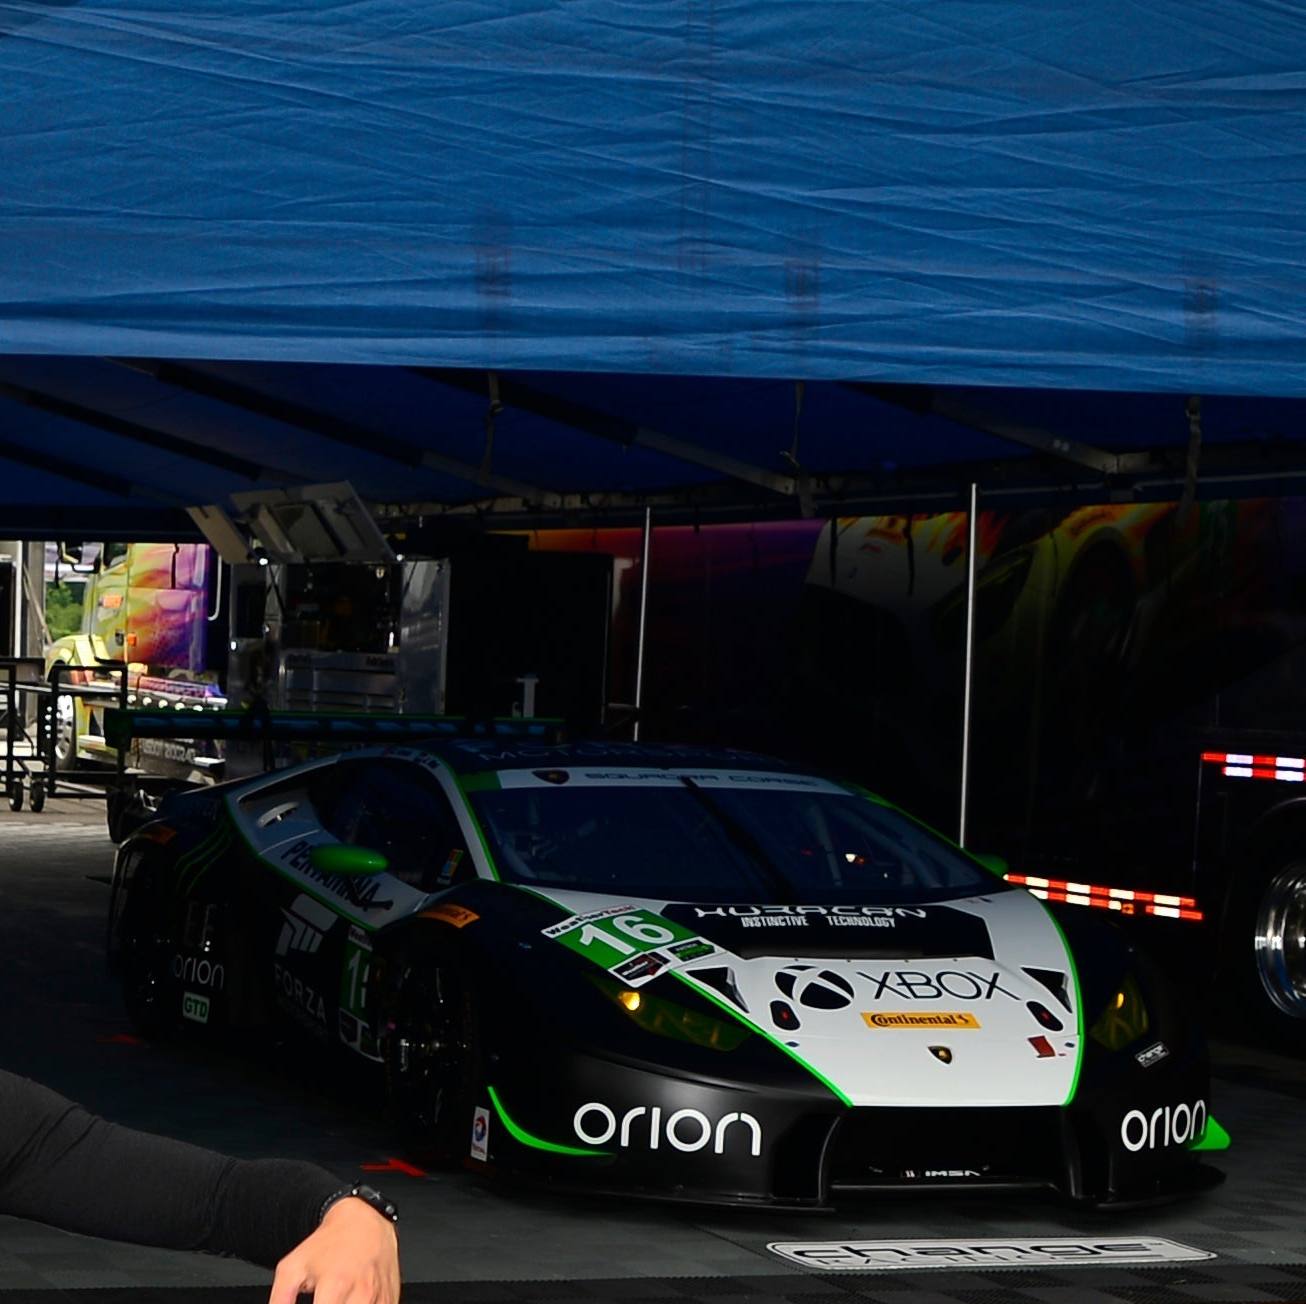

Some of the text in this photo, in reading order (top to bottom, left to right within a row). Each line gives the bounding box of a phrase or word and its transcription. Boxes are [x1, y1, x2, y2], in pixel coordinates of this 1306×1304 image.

[579, 915, 675, 955] 16
[740, 915, 896, 928] INSTINCTIVE TECHNOLOGY
[172, 953, 226, 990] orion
[855, 971, 1022, 1001] XBOX
[184, 995, 209, 1020] GTD
[273, 961, 330, 1025] FORZA
[869, 1012, 957, 1028] Continental
[572, 1101, 763, 1157] orion
[1119, 1098, 1208, 1153] orion
[793, 1242, 1152, 1259] change
